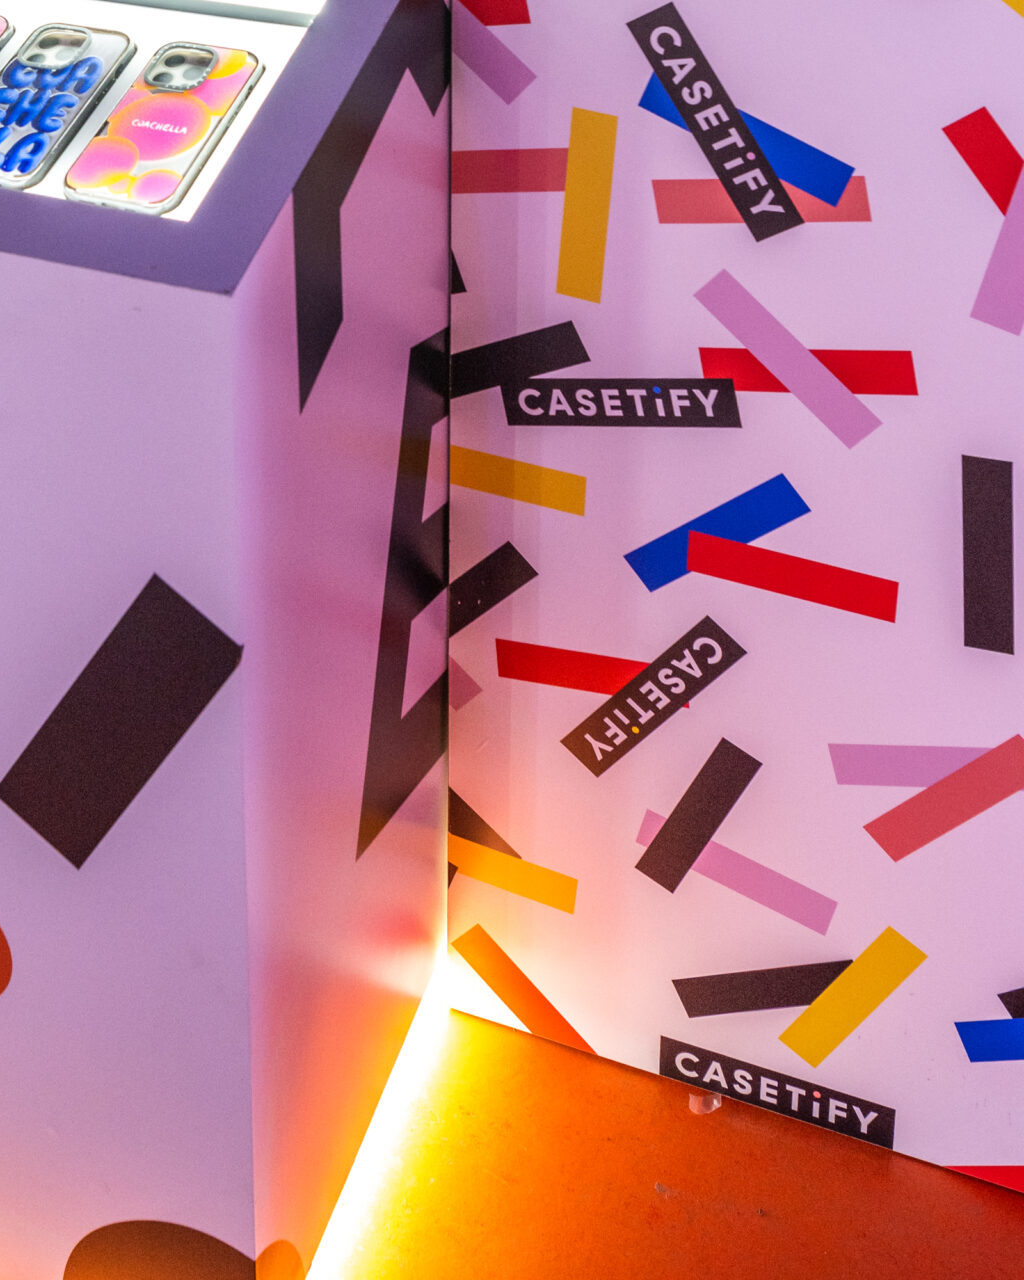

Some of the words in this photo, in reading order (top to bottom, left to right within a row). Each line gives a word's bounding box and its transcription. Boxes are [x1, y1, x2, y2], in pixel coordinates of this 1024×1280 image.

[130, 118, 188, 135] COACHELLA
[649, 25, 785, 217] CASETiFY
[517, 385, 720, 418] CASETiFY
[582, 635, 723, 762] CASETiFY
[674, 1051, 879, 1135] CASETiFY
